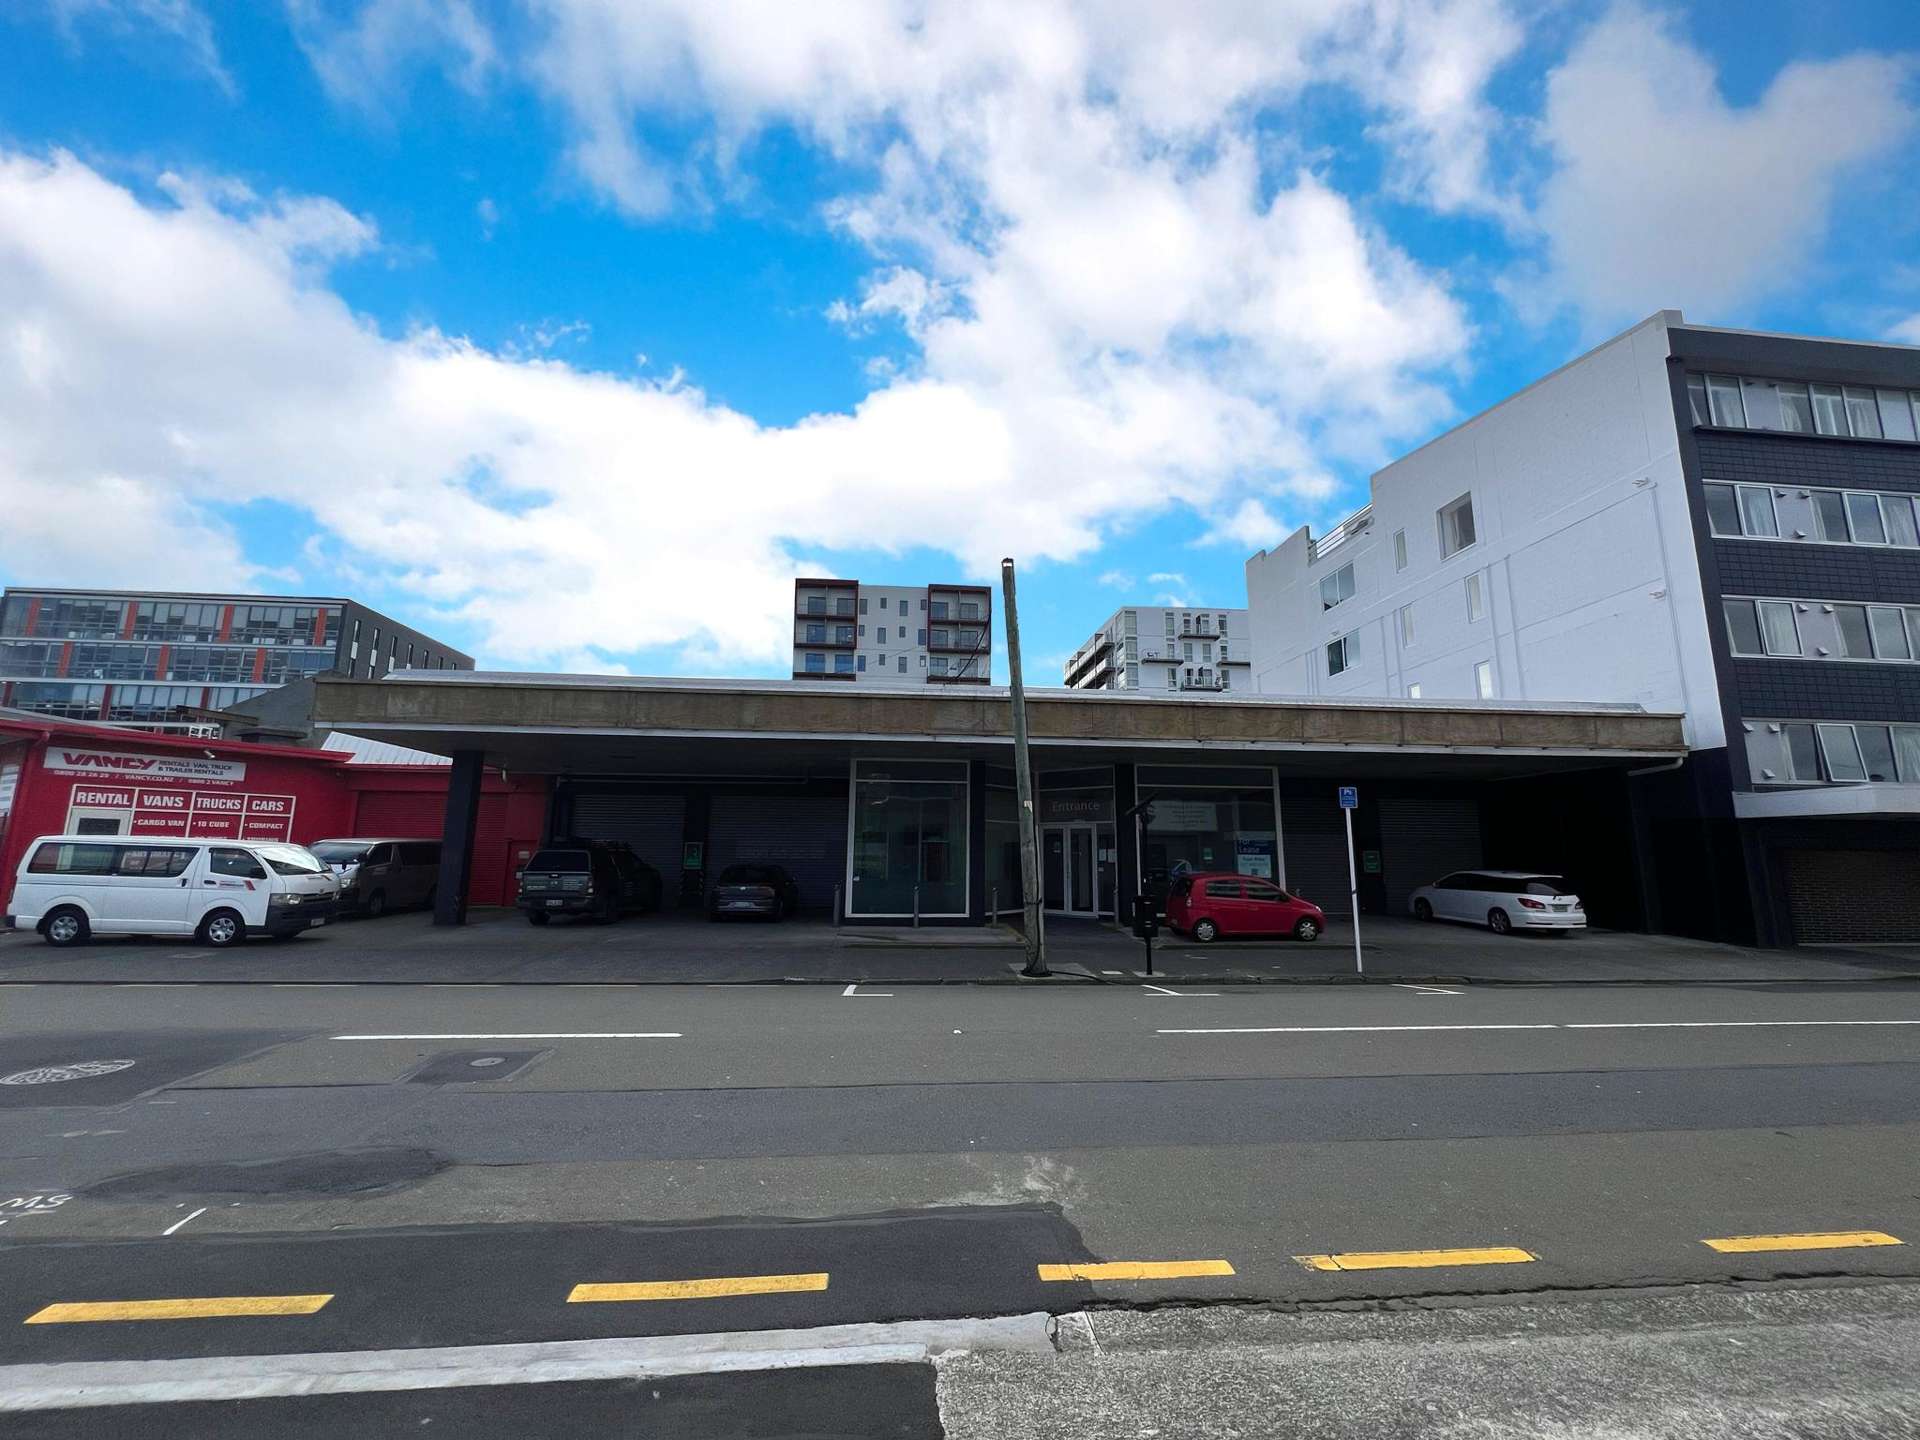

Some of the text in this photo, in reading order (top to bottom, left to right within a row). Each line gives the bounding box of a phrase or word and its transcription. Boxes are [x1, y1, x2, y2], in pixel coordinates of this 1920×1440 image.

[63, 753, 157, 769] VANCY
[194, 768, 224, 776] RENTALS
[76, 791, 130, 804] RENTAL
[143, 795, 184, 807] VANS
[196, 798, 242, 810] TRUCKS
[251, 800, 285, 811] CARS
[1052, 799, 1101, 813] Entrance
[137, 818, 165, 826] CARGO
